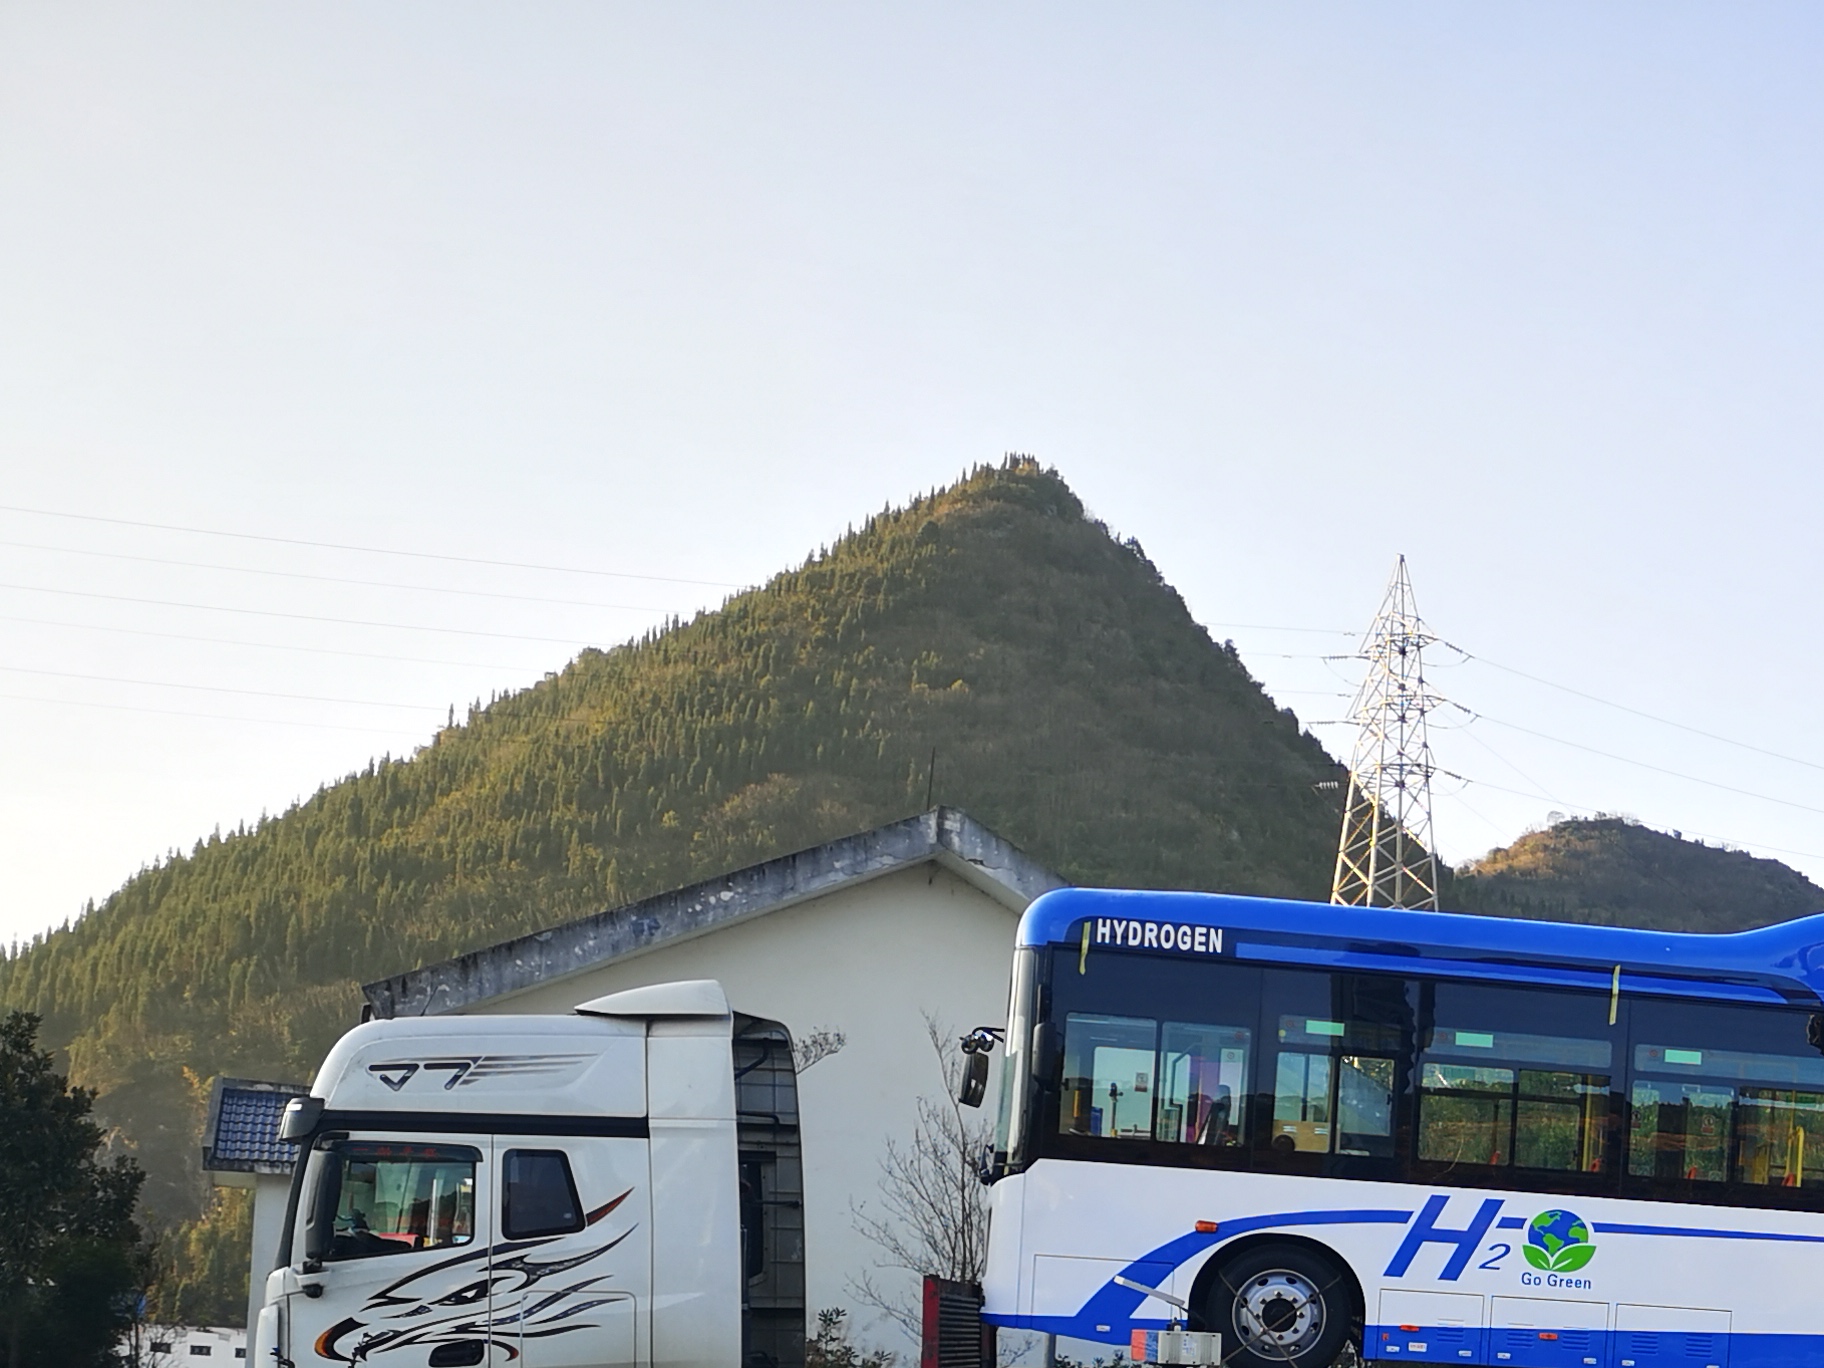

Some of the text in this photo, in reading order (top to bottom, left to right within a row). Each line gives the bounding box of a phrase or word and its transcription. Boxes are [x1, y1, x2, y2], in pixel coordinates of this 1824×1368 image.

[1096, 918, 1223, 953] HYDROGEN
[1521, 1272, 1592, 1290] Go Green
